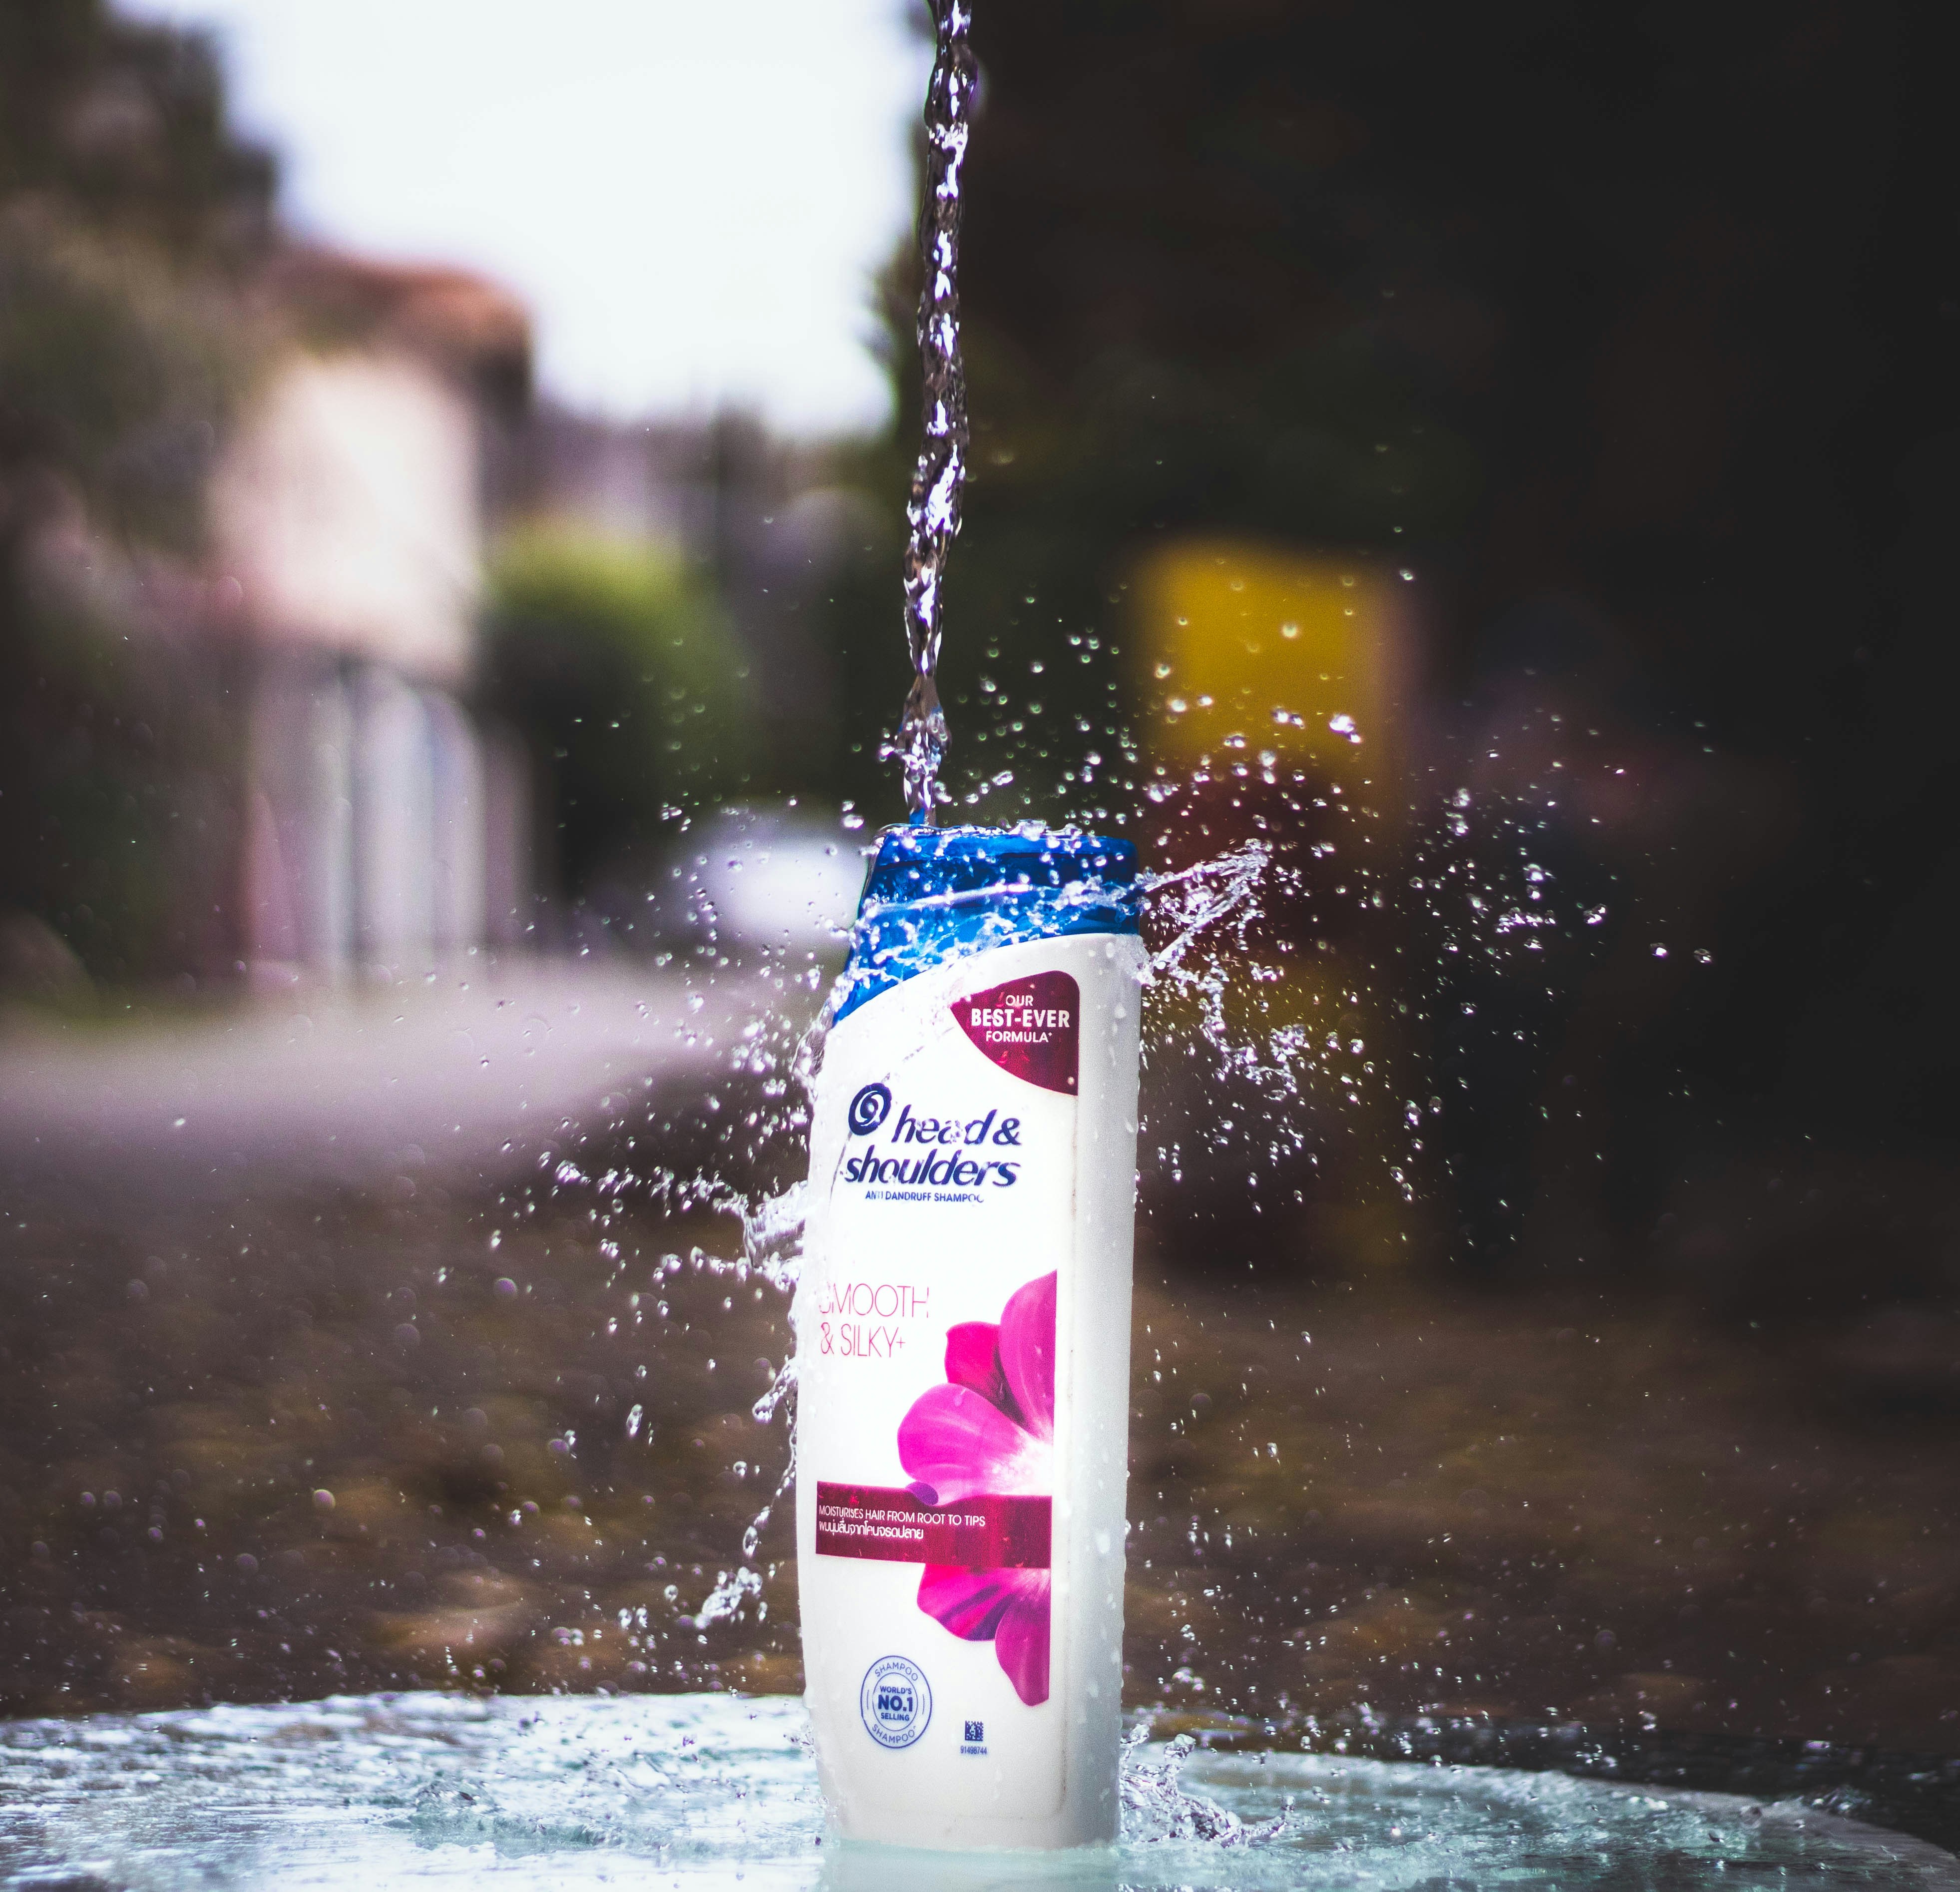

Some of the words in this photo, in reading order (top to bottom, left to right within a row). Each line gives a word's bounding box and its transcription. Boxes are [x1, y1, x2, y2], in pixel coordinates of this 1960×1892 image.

[1005, 995, 1034, 1007] OUR
[971, 1008, 1070, 1028] BEST-EVER
[992, 1118, 1022, 1145] &
[844, 1144, 1021, 1187] shoulders
[885, 1191, 931, 1201] DANDRUFF
[820, 1322, 834, 1355] &
[819, 1505, 863, 1519] MOISTURISES
[865, 1509, 886, 1521] HAIR
[887, 1511, 915, 1523] FROM
[917, 1512, 946, 1524] ROOT
[948, 1514, 962, 1525] TO
[964, 1515, 986, 1526] TIPS
[874, 1661, 918, 1681] SHAMPOO
[879, 1685, 912, 1694] WORLD'S
[878, 1694, 913, 1712] NO.1
[881, 1712, 910, 1721] SELLING
